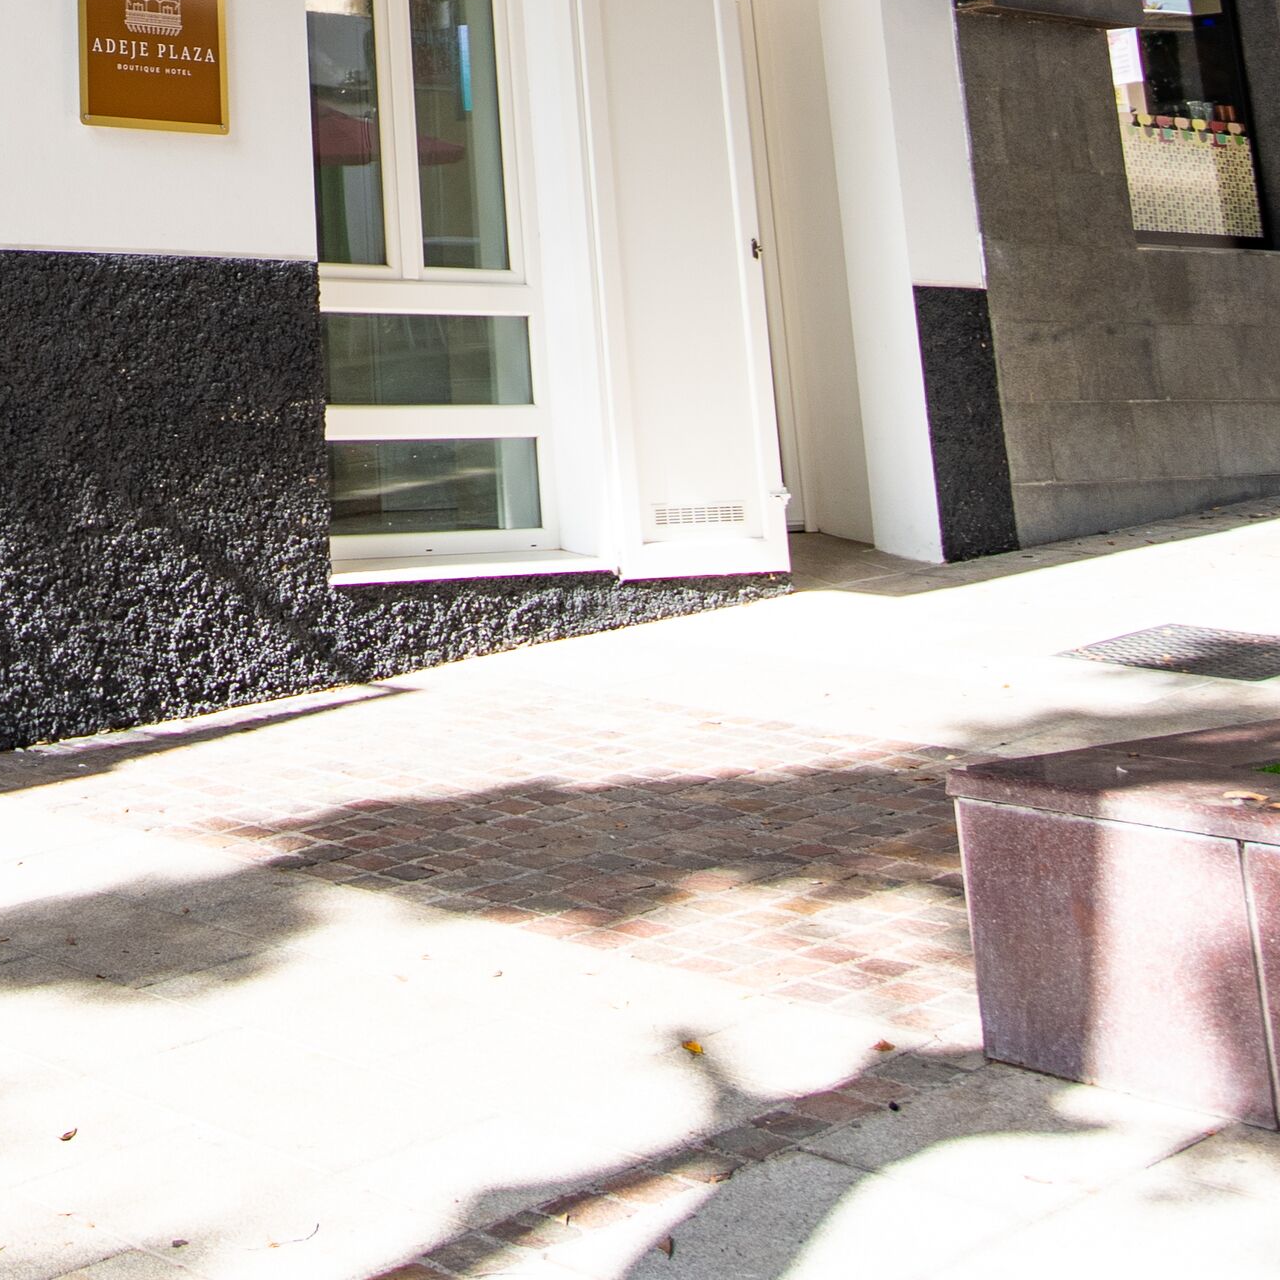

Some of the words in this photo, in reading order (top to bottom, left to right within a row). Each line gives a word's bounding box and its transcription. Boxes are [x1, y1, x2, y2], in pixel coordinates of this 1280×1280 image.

[91, 37, 149, 60] ADEJE
[157, 43, 216, 63] PLAZA
[116, 63, 161, 74] BOUTIQUE
[165, 68, 192, 76] HOTEL
